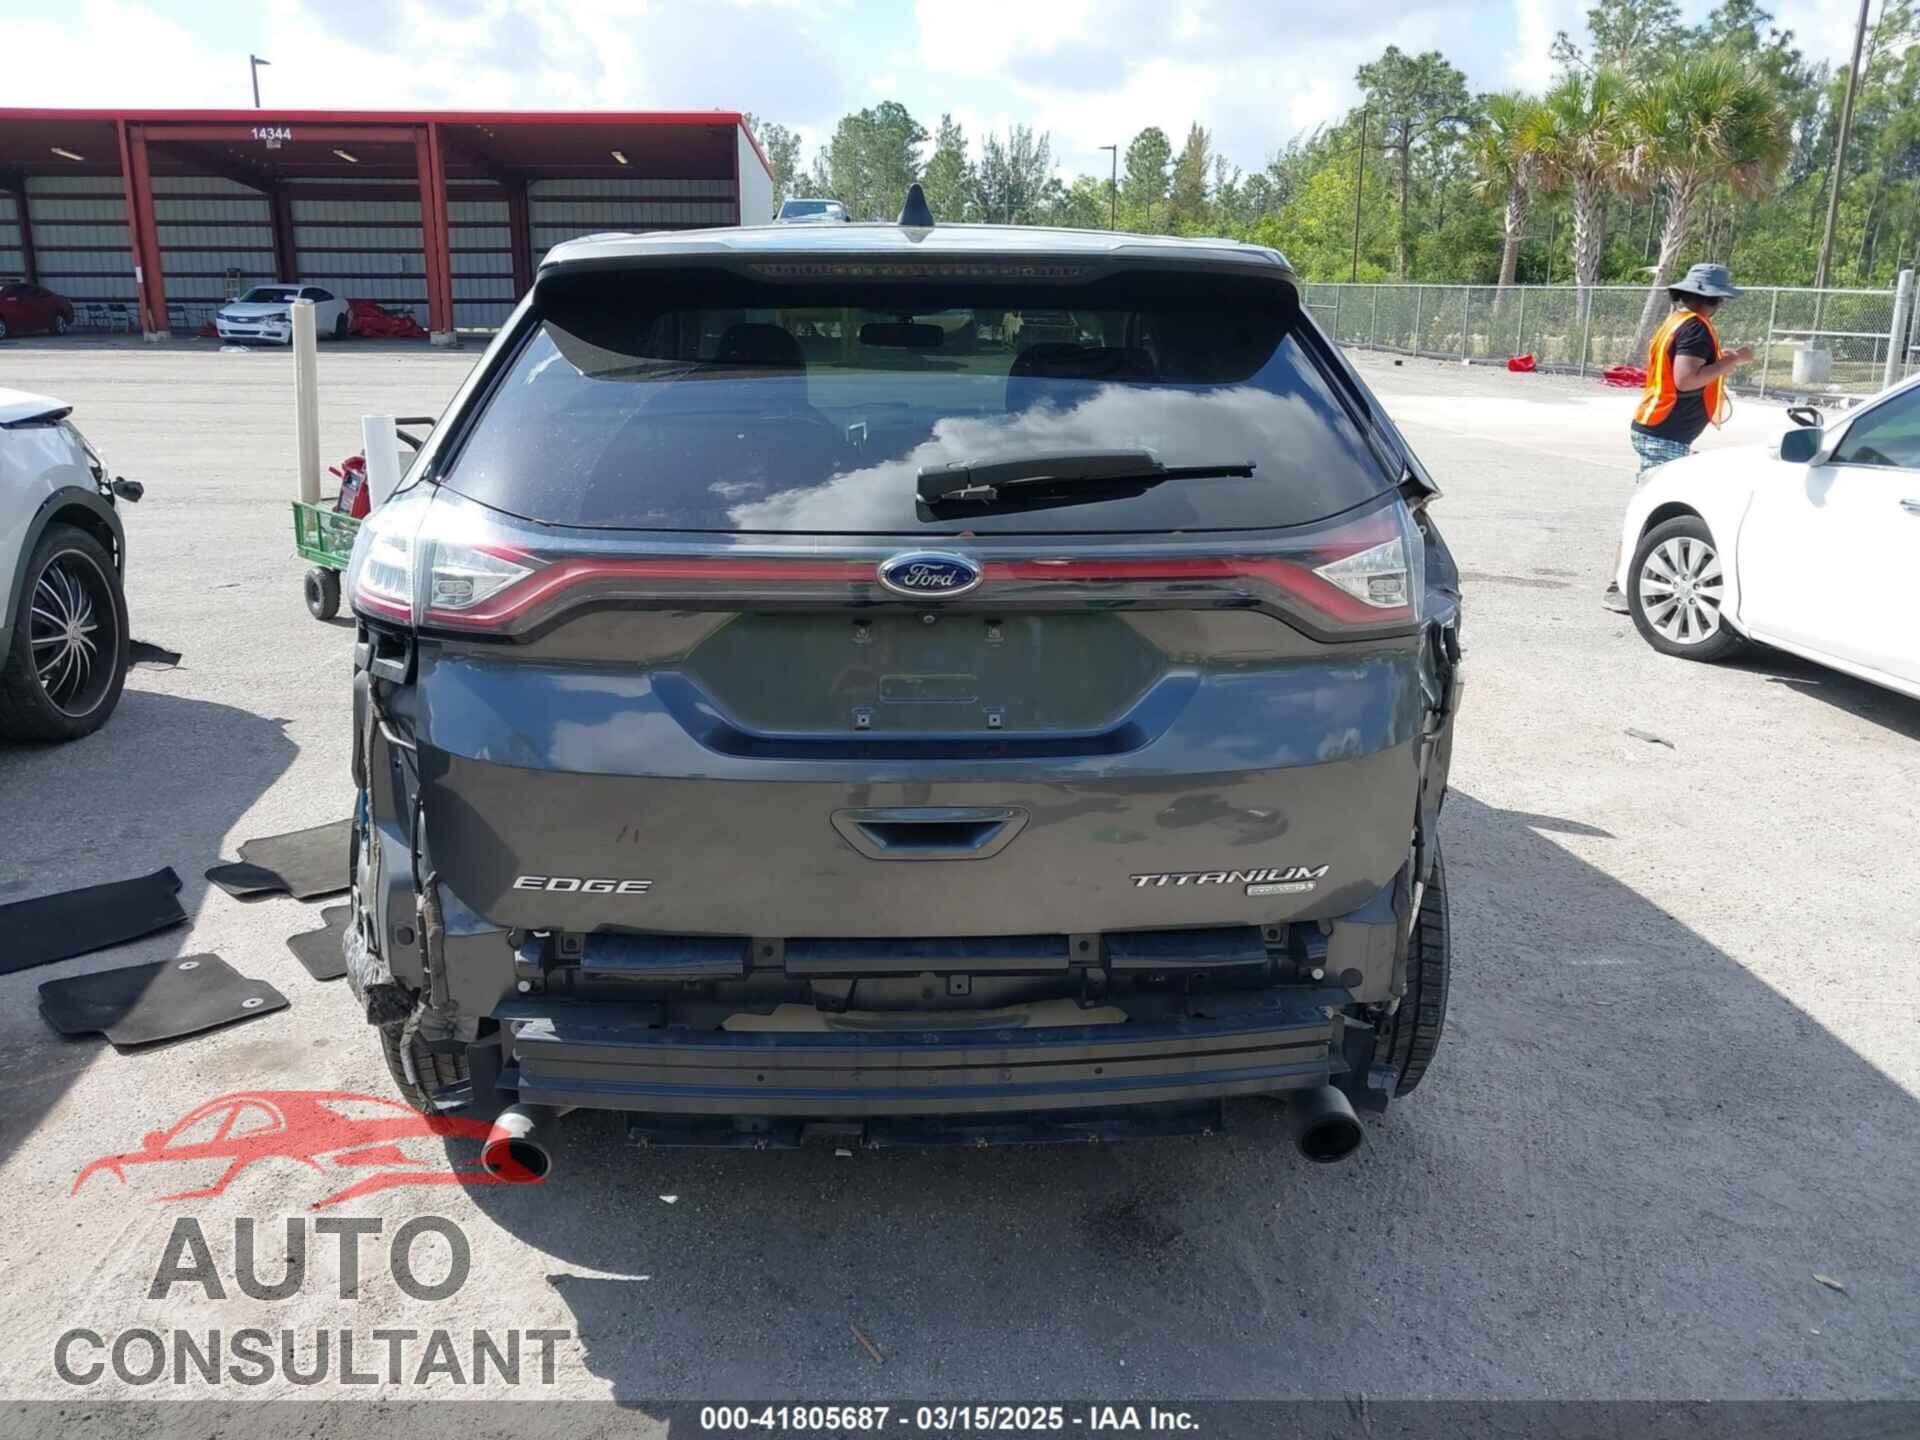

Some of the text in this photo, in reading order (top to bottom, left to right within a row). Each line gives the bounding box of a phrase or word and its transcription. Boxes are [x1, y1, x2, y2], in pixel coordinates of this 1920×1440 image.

[251, 127, 291, 140] 14344
[904, 563, 958, 586] Ford
[512, 875, 653, 894] EDGE
[1130, 864, 1330, 888] TITANIUM
